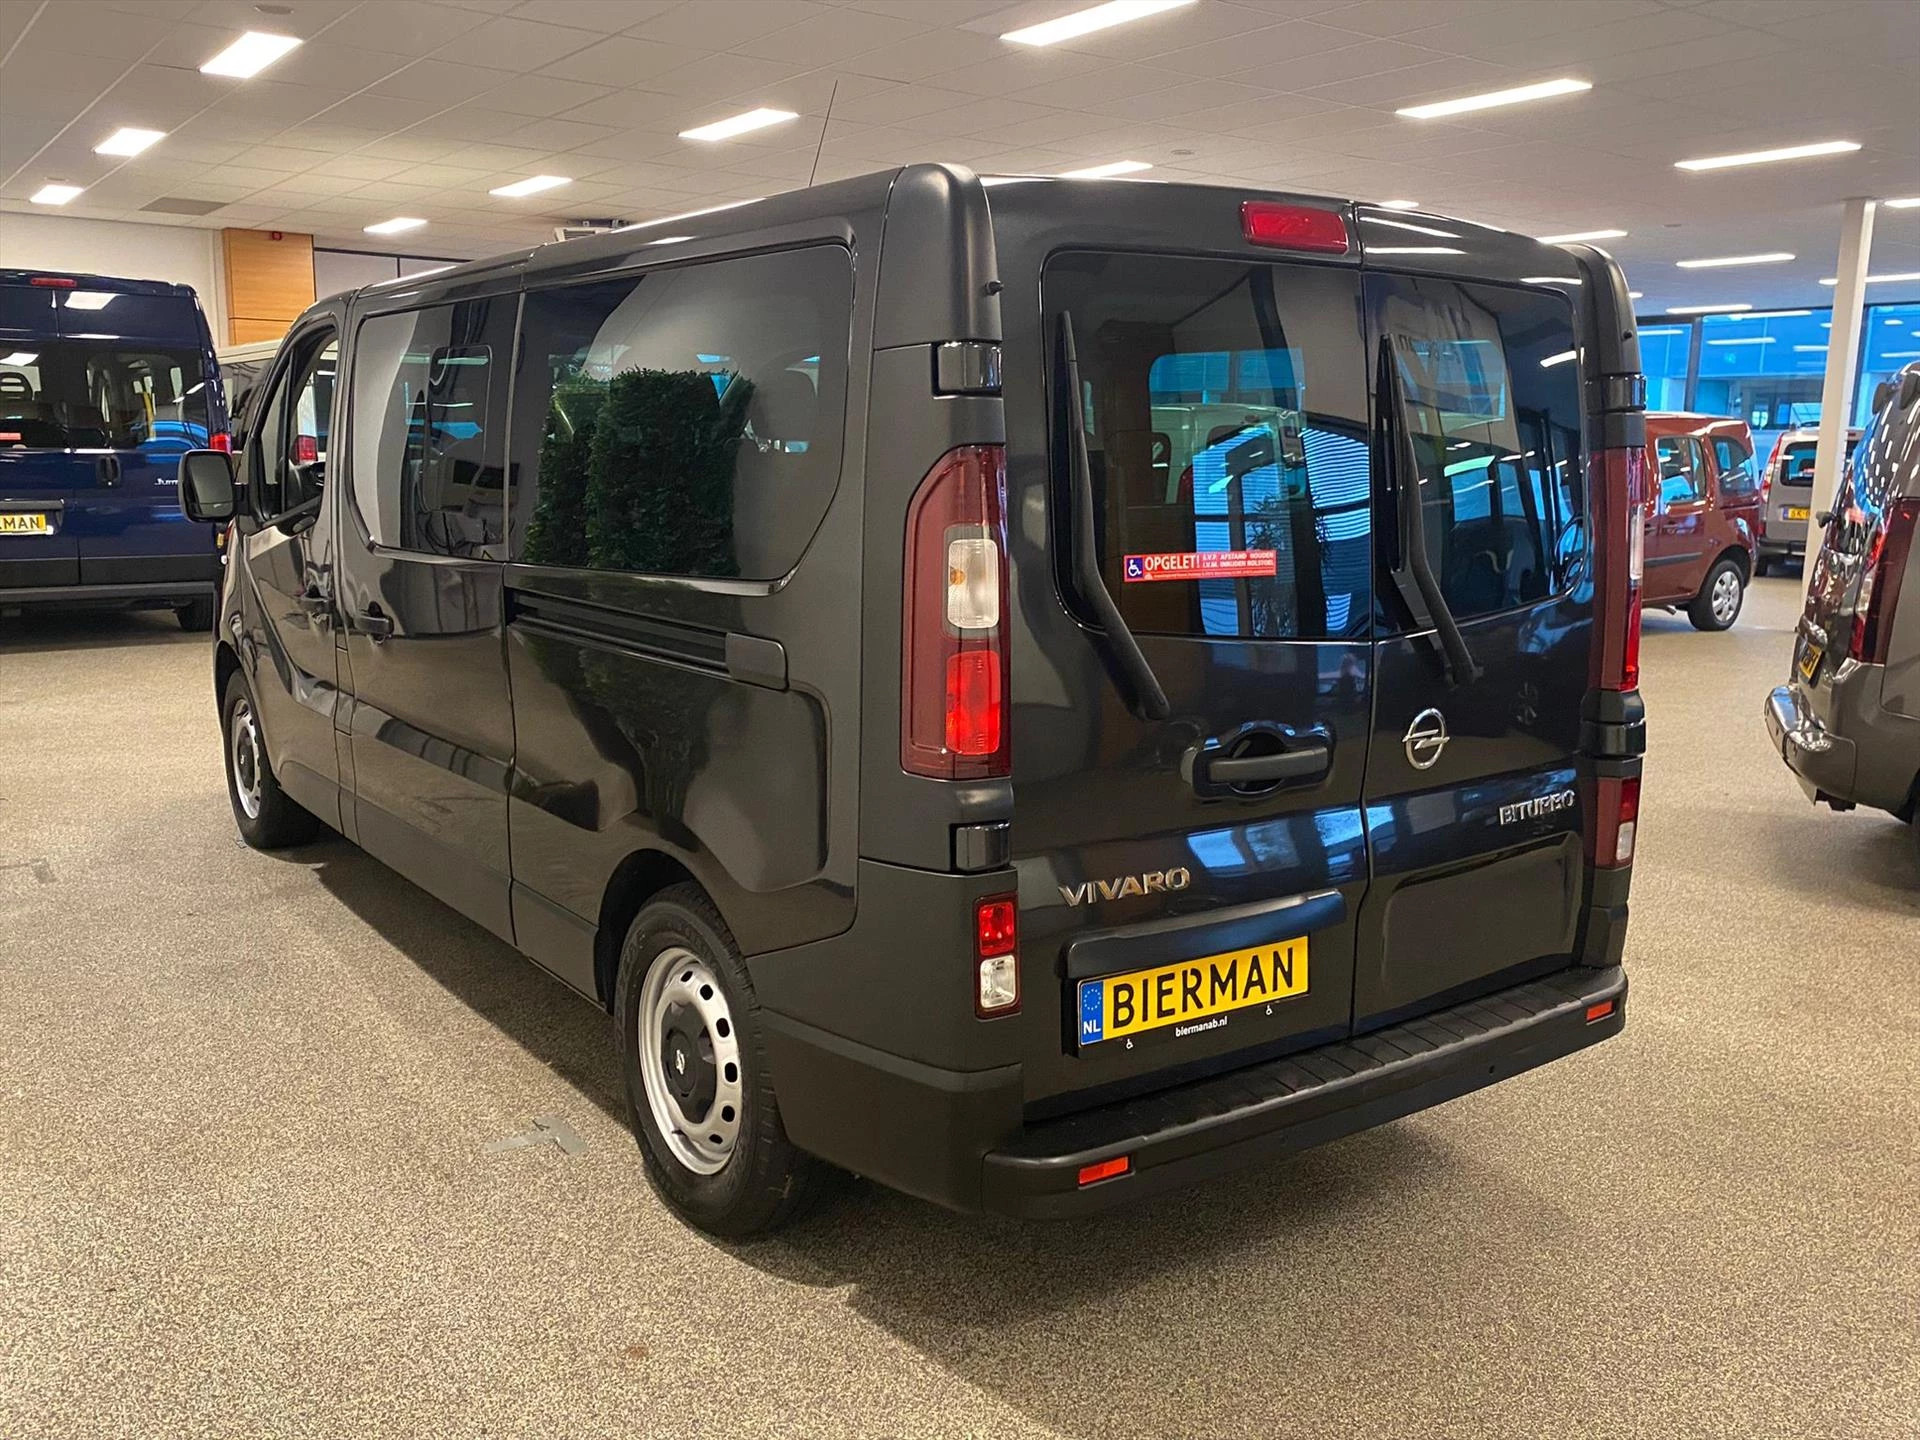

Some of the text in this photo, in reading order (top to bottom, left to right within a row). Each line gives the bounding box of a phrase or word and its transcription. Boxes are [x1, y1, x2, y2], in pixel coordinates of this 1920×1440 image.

[0, 516, 40, 530] MAN
[1144, 555, 1200, 571] OPGELET!
[1499, 789, 1576, 825] BITURBO
[1058, 866, 1191, 908] VIVARO
[1083, 947, 1293, 1035] NL BIERMAN
[1175, 1015, 1228, 1037] biermanab.nl
